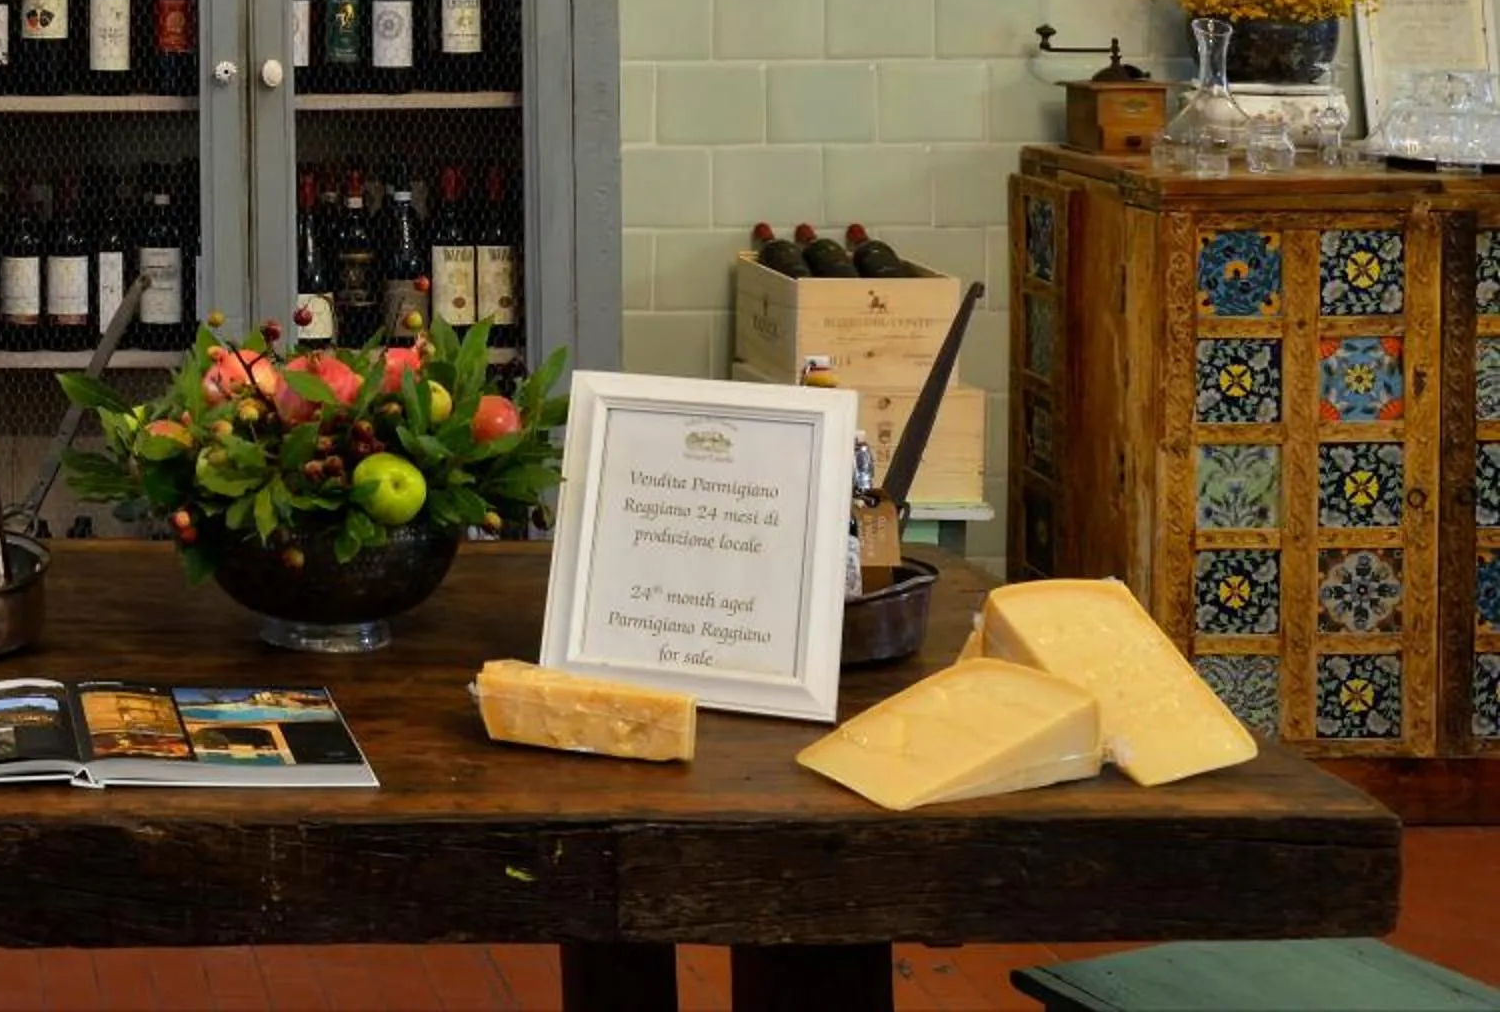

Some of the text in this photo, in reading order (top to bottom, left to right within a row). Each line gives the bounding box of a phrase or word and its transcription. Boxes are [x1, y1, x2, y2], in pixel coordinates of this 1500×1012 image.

[630, 470, 780, 502] Vendita Parmigiano
[623, 496, 780, 527] Reggiano 24 mesi di
[632, 527, 763, 554] produzione locale
[666, 591, 716, 609] month
[719, 596, 756, 616] aged
[607, 610, 772, 645] Parmigiano Reggiano
[658, 643, 714, 667] for sale
